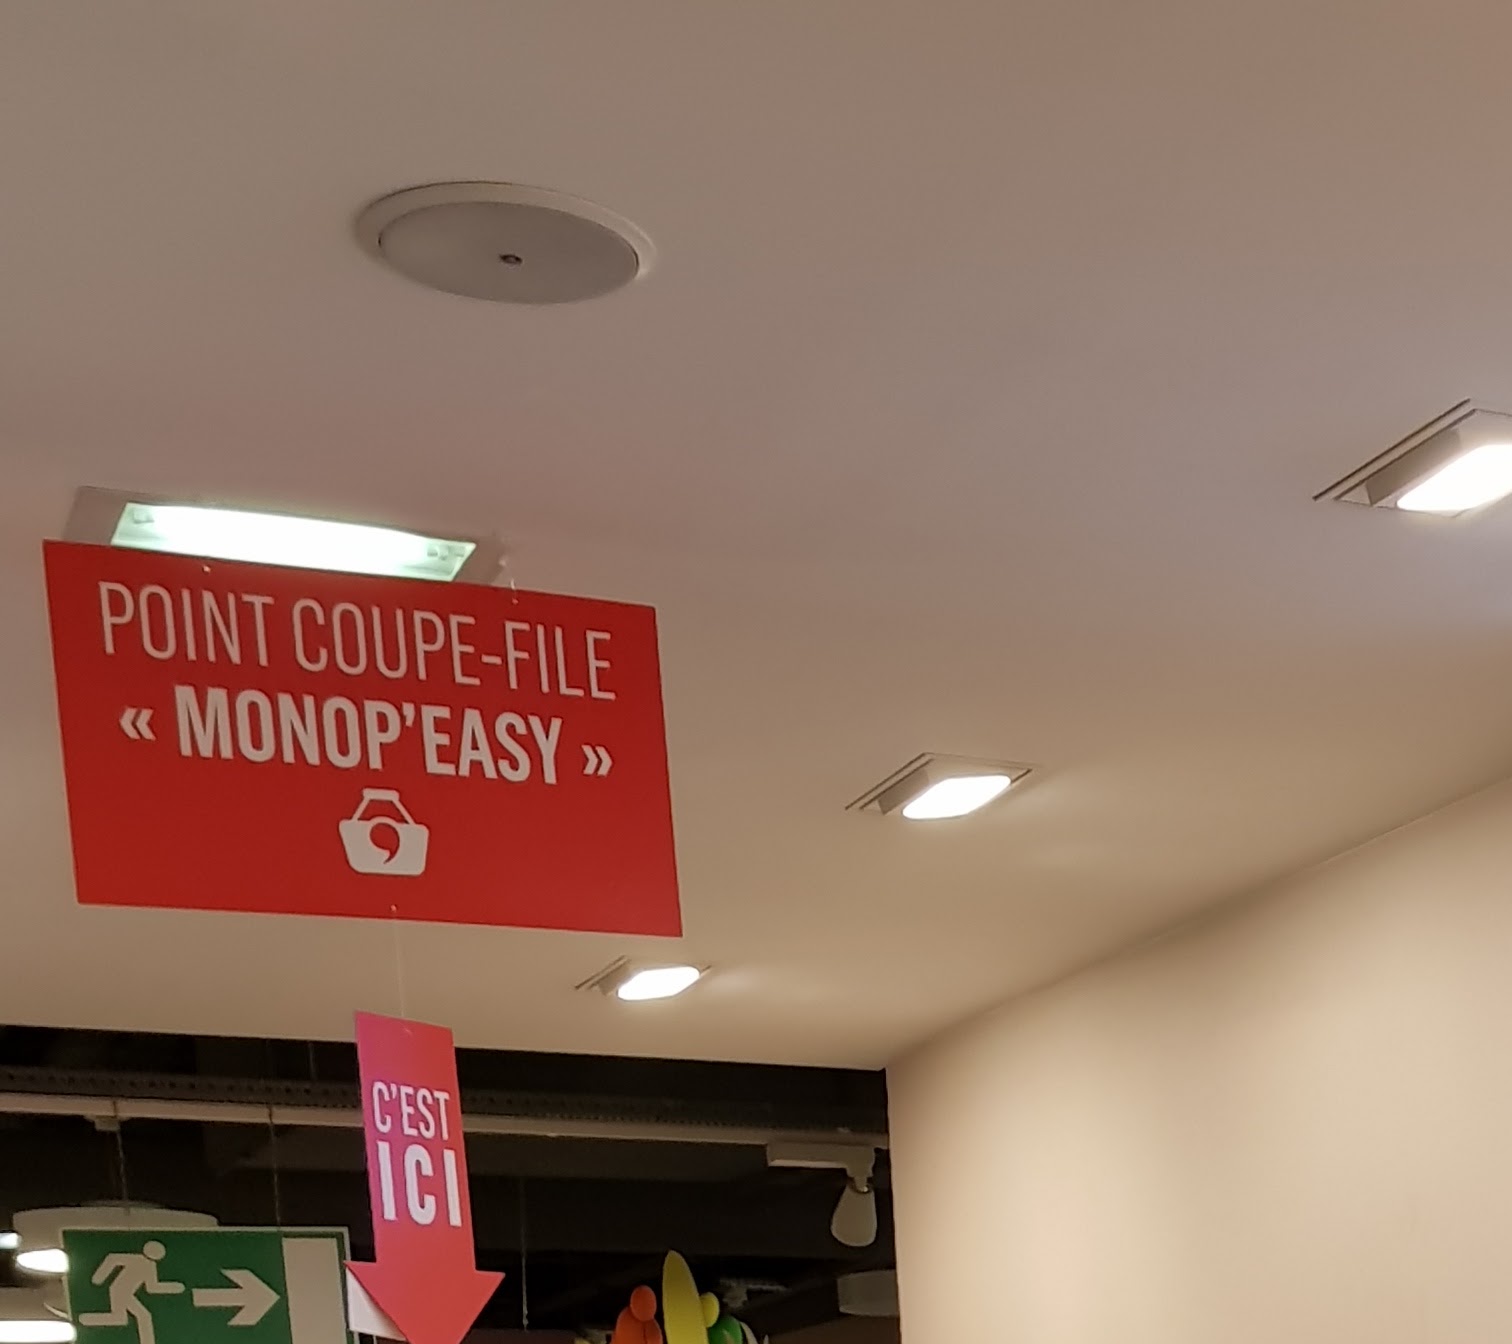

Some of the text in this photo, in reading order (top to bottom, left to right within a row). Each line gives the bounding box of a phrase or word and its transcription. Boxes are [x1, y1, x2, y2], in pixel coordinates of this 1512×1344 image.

[98, 580, 617, 701] POINT COUPE-FILE
[174, 684, 563, 786] MONOP'EASY
[372, 1080, 463, 1228] C'EST ICI
